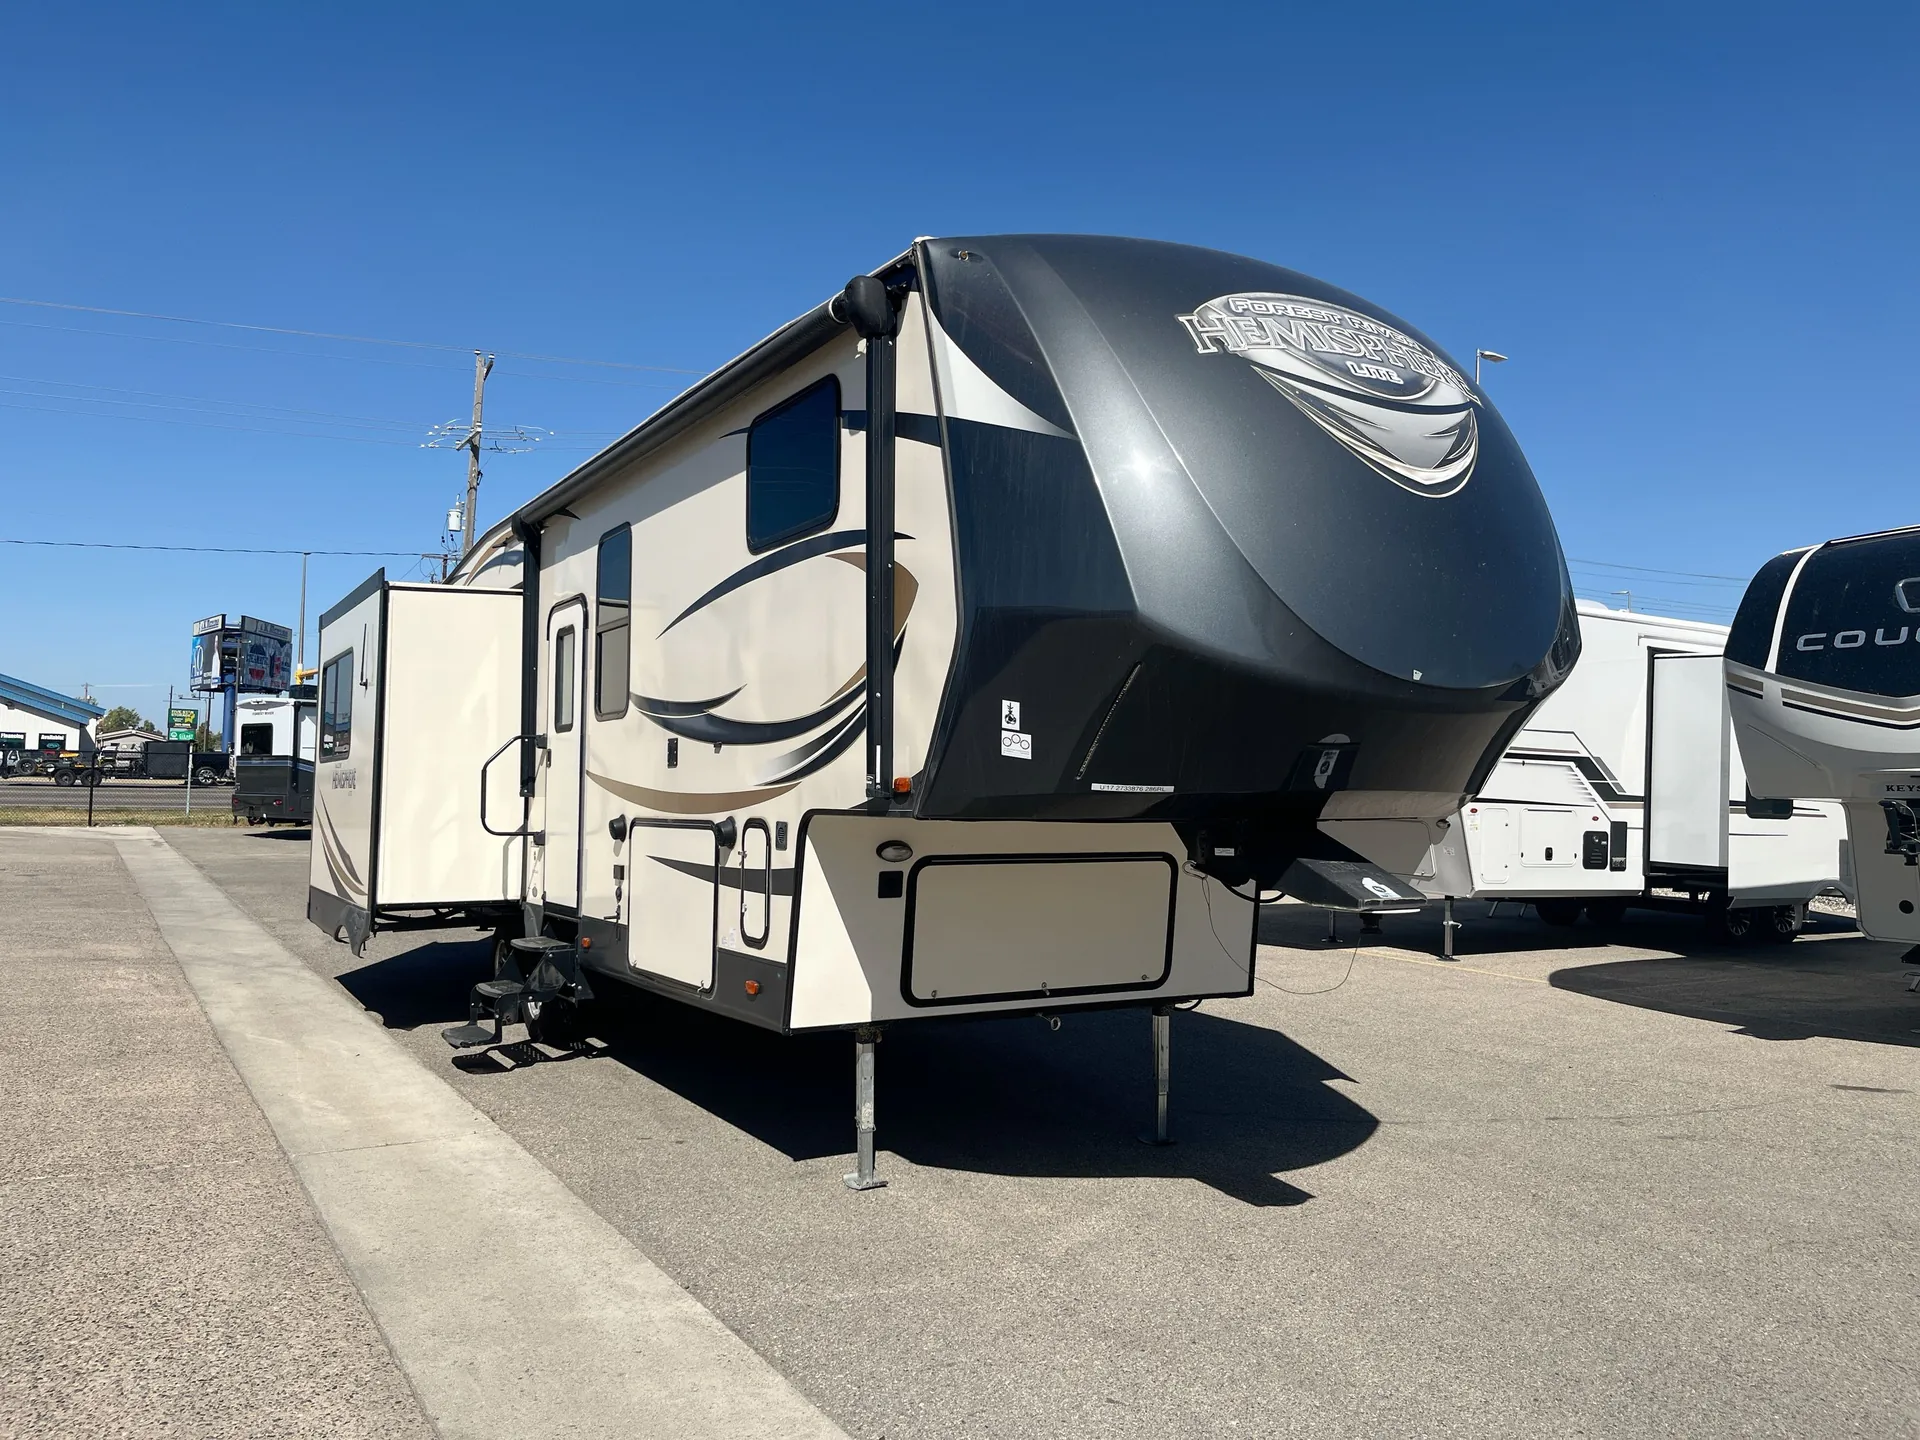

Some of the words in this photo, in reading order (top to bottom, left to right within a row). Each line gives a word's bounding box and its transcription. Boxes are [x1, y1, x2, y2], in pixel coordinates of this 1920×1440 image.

[1228, 298, 1342, 324] FOREST
[1344, 314, 1424, 351] RIVER
[1175, 313, 1484, 408] HEMISPHERE
[1345, 361, 1404, 385] LITE
[1796, 626, 1920, 652] COU
